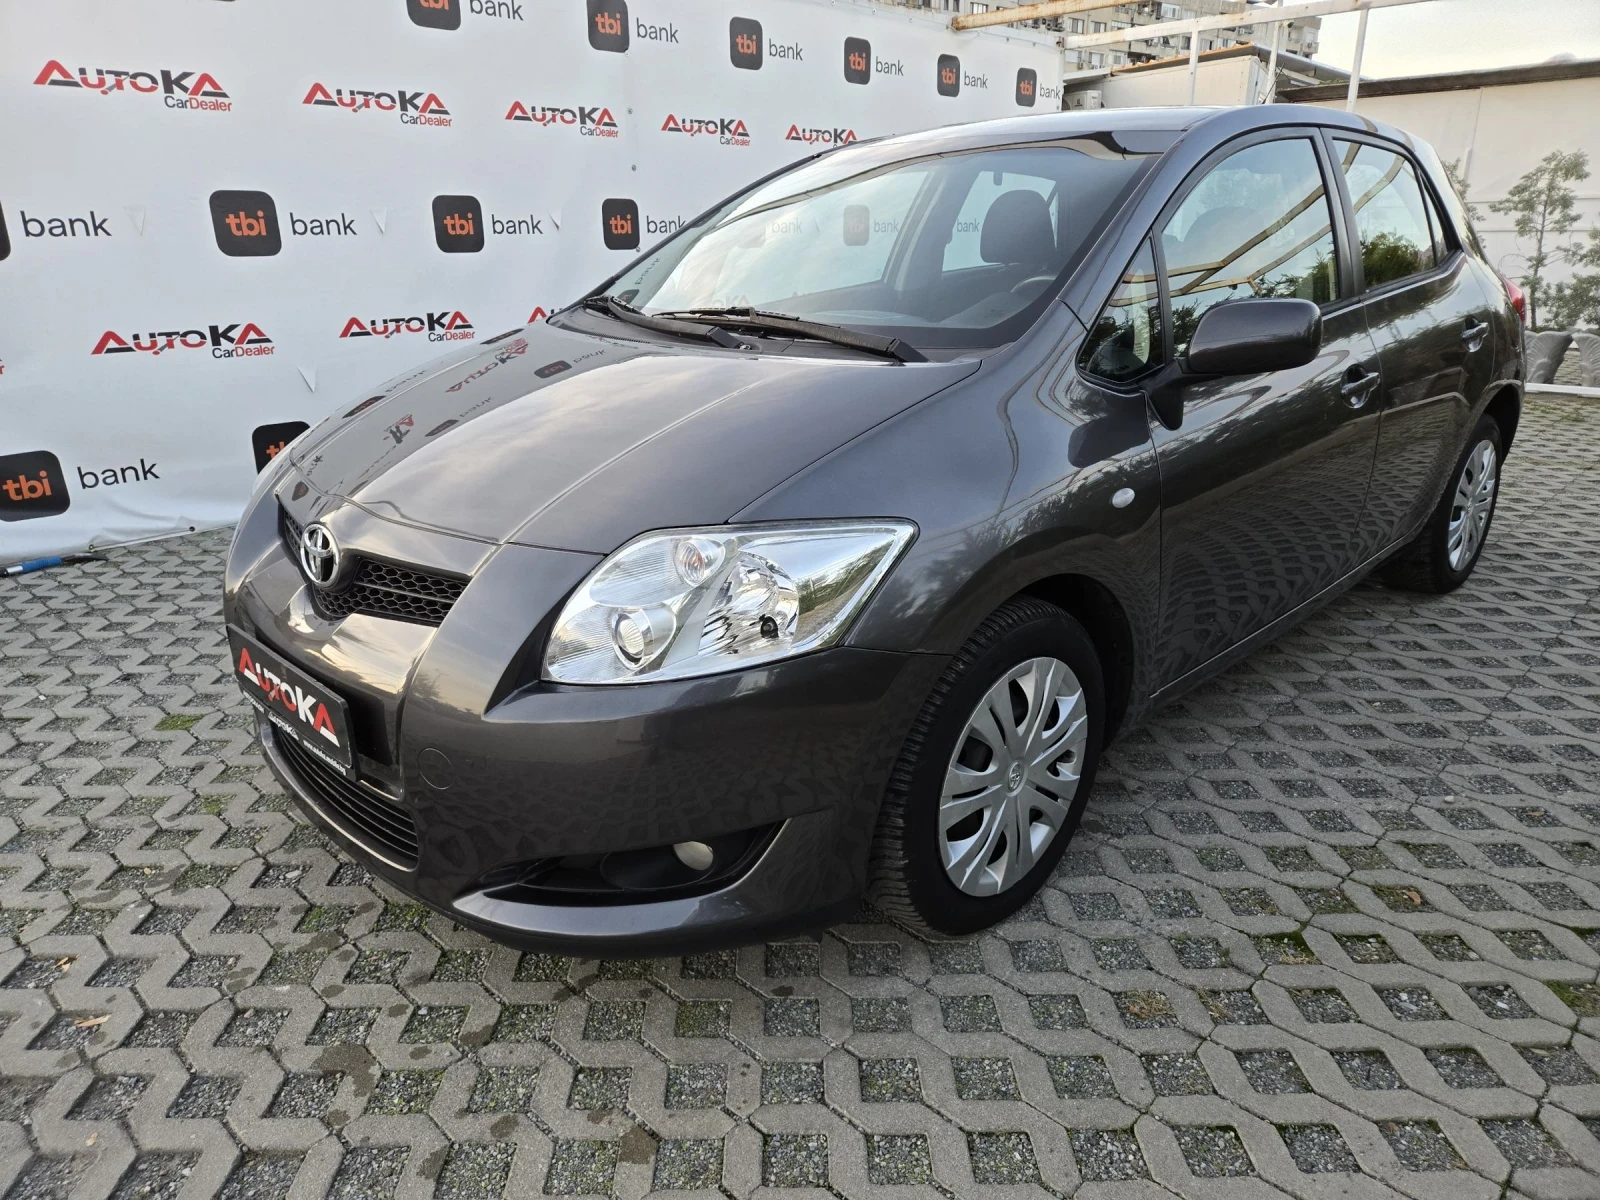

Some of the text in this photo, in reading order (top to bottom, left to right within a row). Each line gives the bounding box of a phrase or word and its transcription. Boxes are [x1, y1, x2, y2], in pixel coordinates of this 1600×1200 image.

[595, 12, 679, 44] tbi bank
[736, 34, 803, 61] tbi bank
[849, 52, 904, 76] tbi bank
[941, 68, 988, 89] tbi bank
[1020, 80, 1061, 100] tbi bank
[164, 95, 232, 112] CarDealer
[400, 112, 452, 127] CarDealer
[579, 125, 619, 138] CarDealer
[719, 135, 750, 147] CarDealer
[20, 210, 112, 238] bank
[225, 210, 358, 237] tbi bank
[443, 212, 543, 236] tbi bank
[609, 213, 632, 235] tbi
[956, 218, 980, 233] bank
[428, 329, 476, 342] CarDealer
[211, 345, 276, 359] CarDealer
[2, 458, 161, 501] tbi bank
